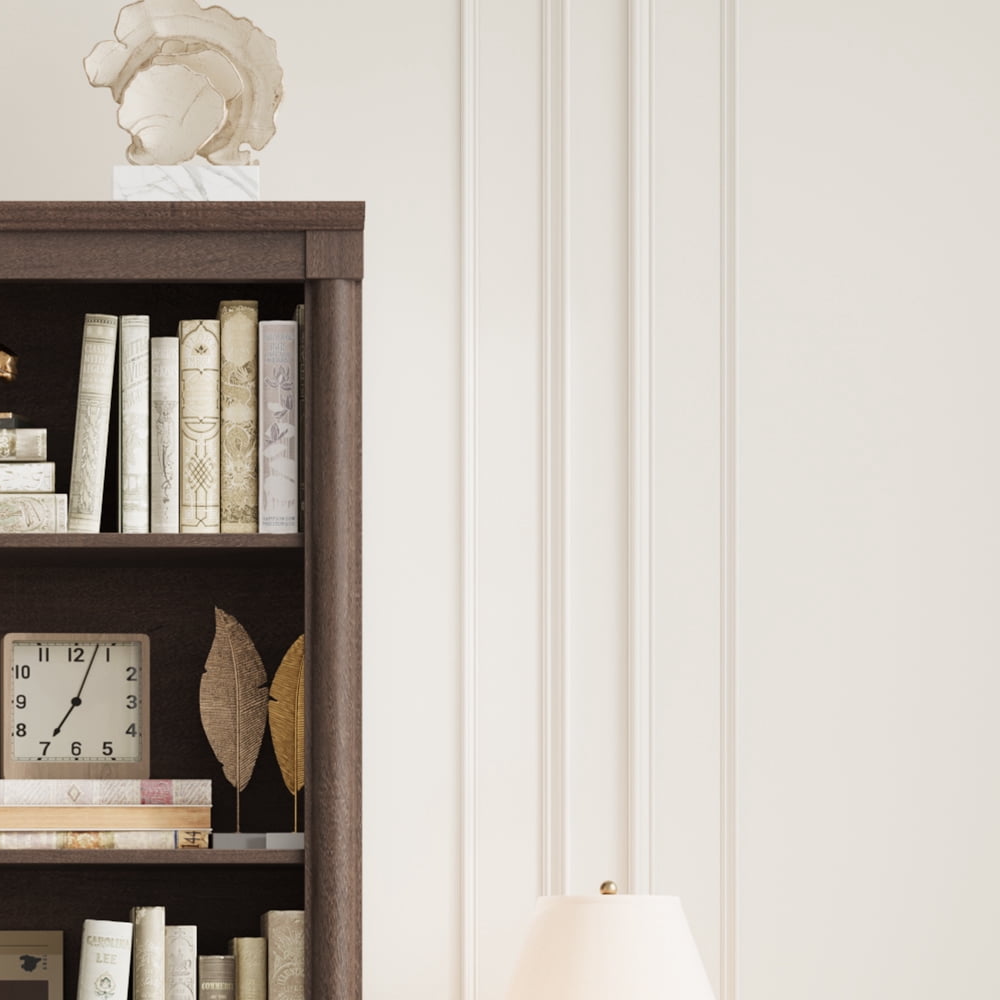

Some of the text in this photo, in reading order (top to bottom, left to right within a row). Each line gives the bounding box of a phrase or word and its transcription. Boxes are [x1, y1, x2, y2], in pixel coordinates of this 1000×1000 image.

[38, 647, 49, 662] 11
[68, 647, 85, 662] 12
[105, 647, 110, 662] 1
[15, 665, 30, 679] 10
[126, 666, 137, 681] 2
[15, 694, 27, 709] 9
[126, 694, 137, 709] 3
[15, 723, 27, 737] 8
[125, 723, 137, 737] 4
[39, 741, 51, 756] 7
[71, 741, 82, 756] 6
[102, 741, 113, 756] 5
[96, 952, 118, 964] LEE
